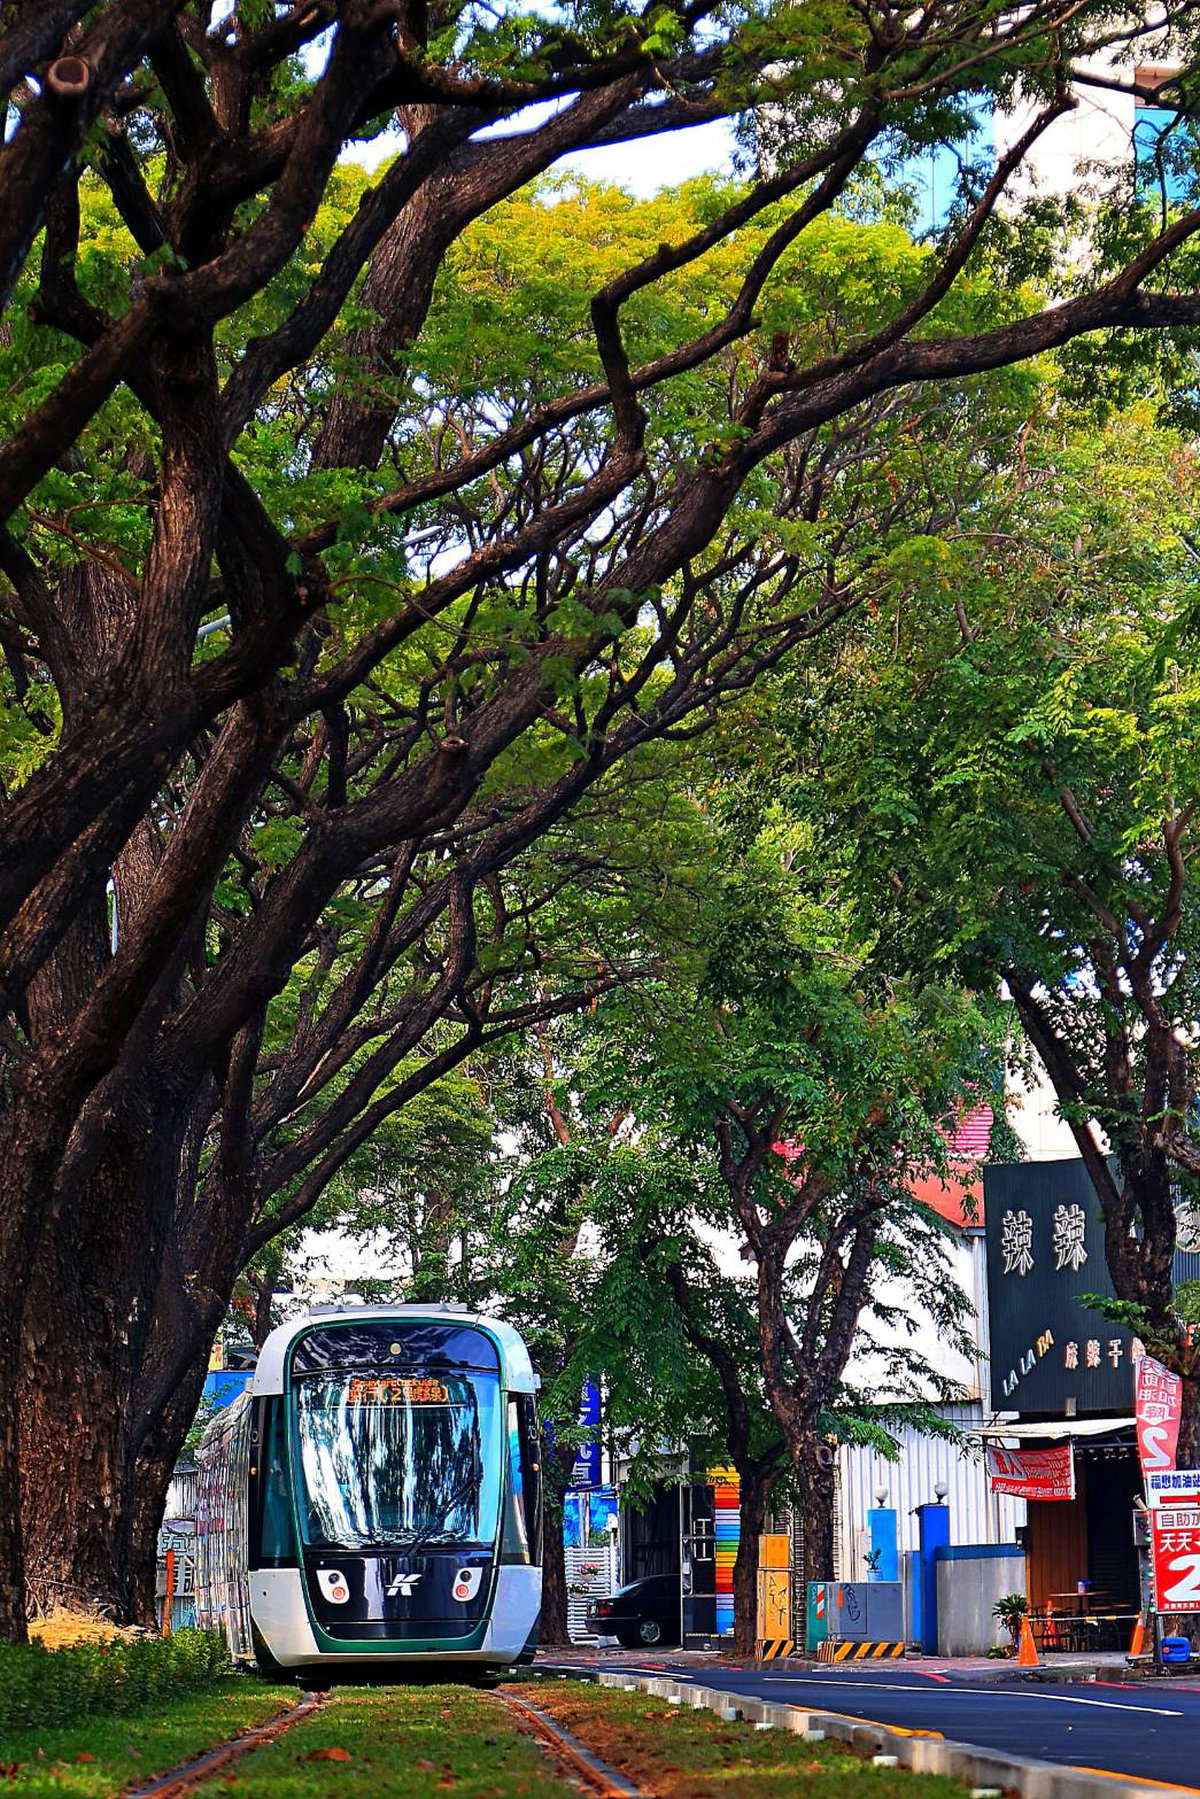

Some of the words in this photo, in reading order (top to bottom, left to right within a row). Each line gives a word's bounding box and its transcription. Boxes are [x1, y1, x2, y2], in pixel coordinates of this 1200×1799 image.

[1002, 1203, 1088, 1277] 辣辣
[1003, 1369, 1020, 1397] LA
[1020, 1348, 1037, 1376] LA
